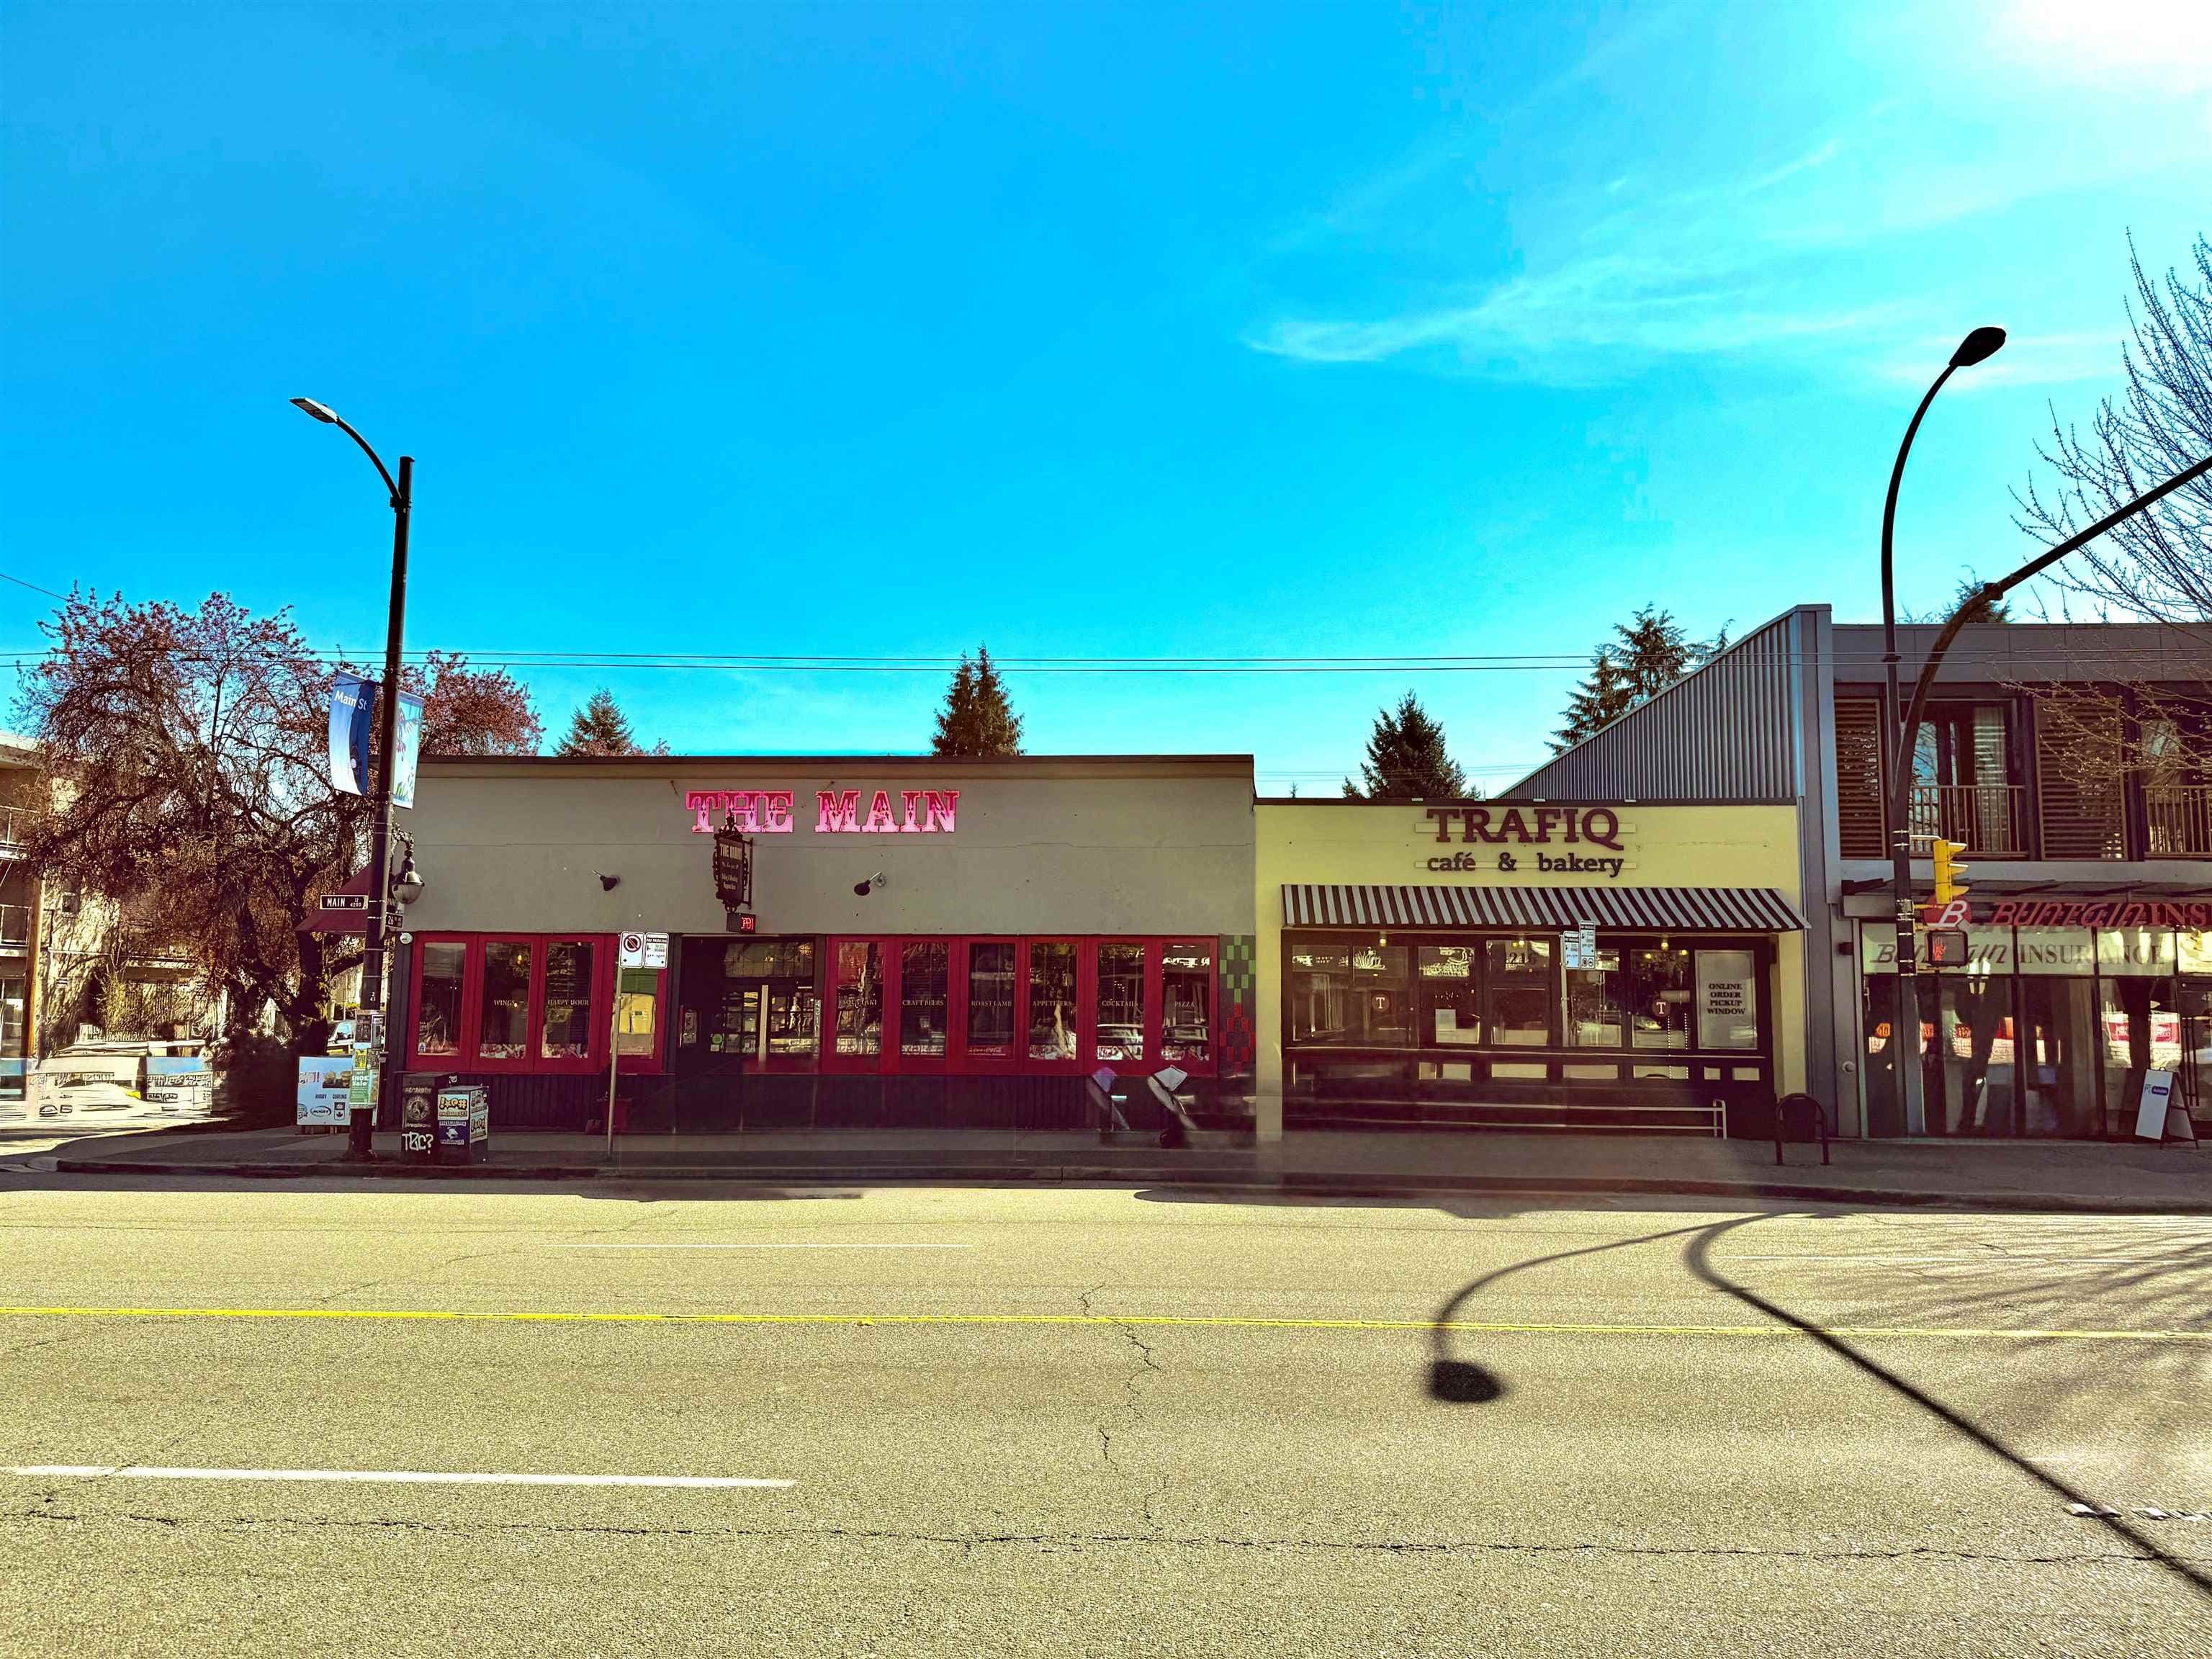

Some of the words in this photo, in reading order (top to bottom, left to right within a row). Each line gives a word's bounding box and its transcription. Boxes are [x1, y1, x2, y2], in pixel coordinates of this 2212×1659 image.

[334, 690, 357, 708] Main
[358, 698, 367, 711] St
[685, 790, 793, 833] THE
[814, 789, 960, 833] MAIN
[1426, 808, 1624, 851] TRAFIQ
[720, 843, 729, 858] THE
[1427, 852, 1476, 872] café
[1498, 852, 1517, 872] &
[1537, 852, 1624, 878] bakery
[326, 897, 346, 907] MAIN
[387, 915, 395, 925] 26
[2149, 902, 2212, 926] INS
[2020, 944, 2165, 964] INSURANCE
[1375, 997, 1385, 1009] T
[1656, 1002, 1666, 1015] T
